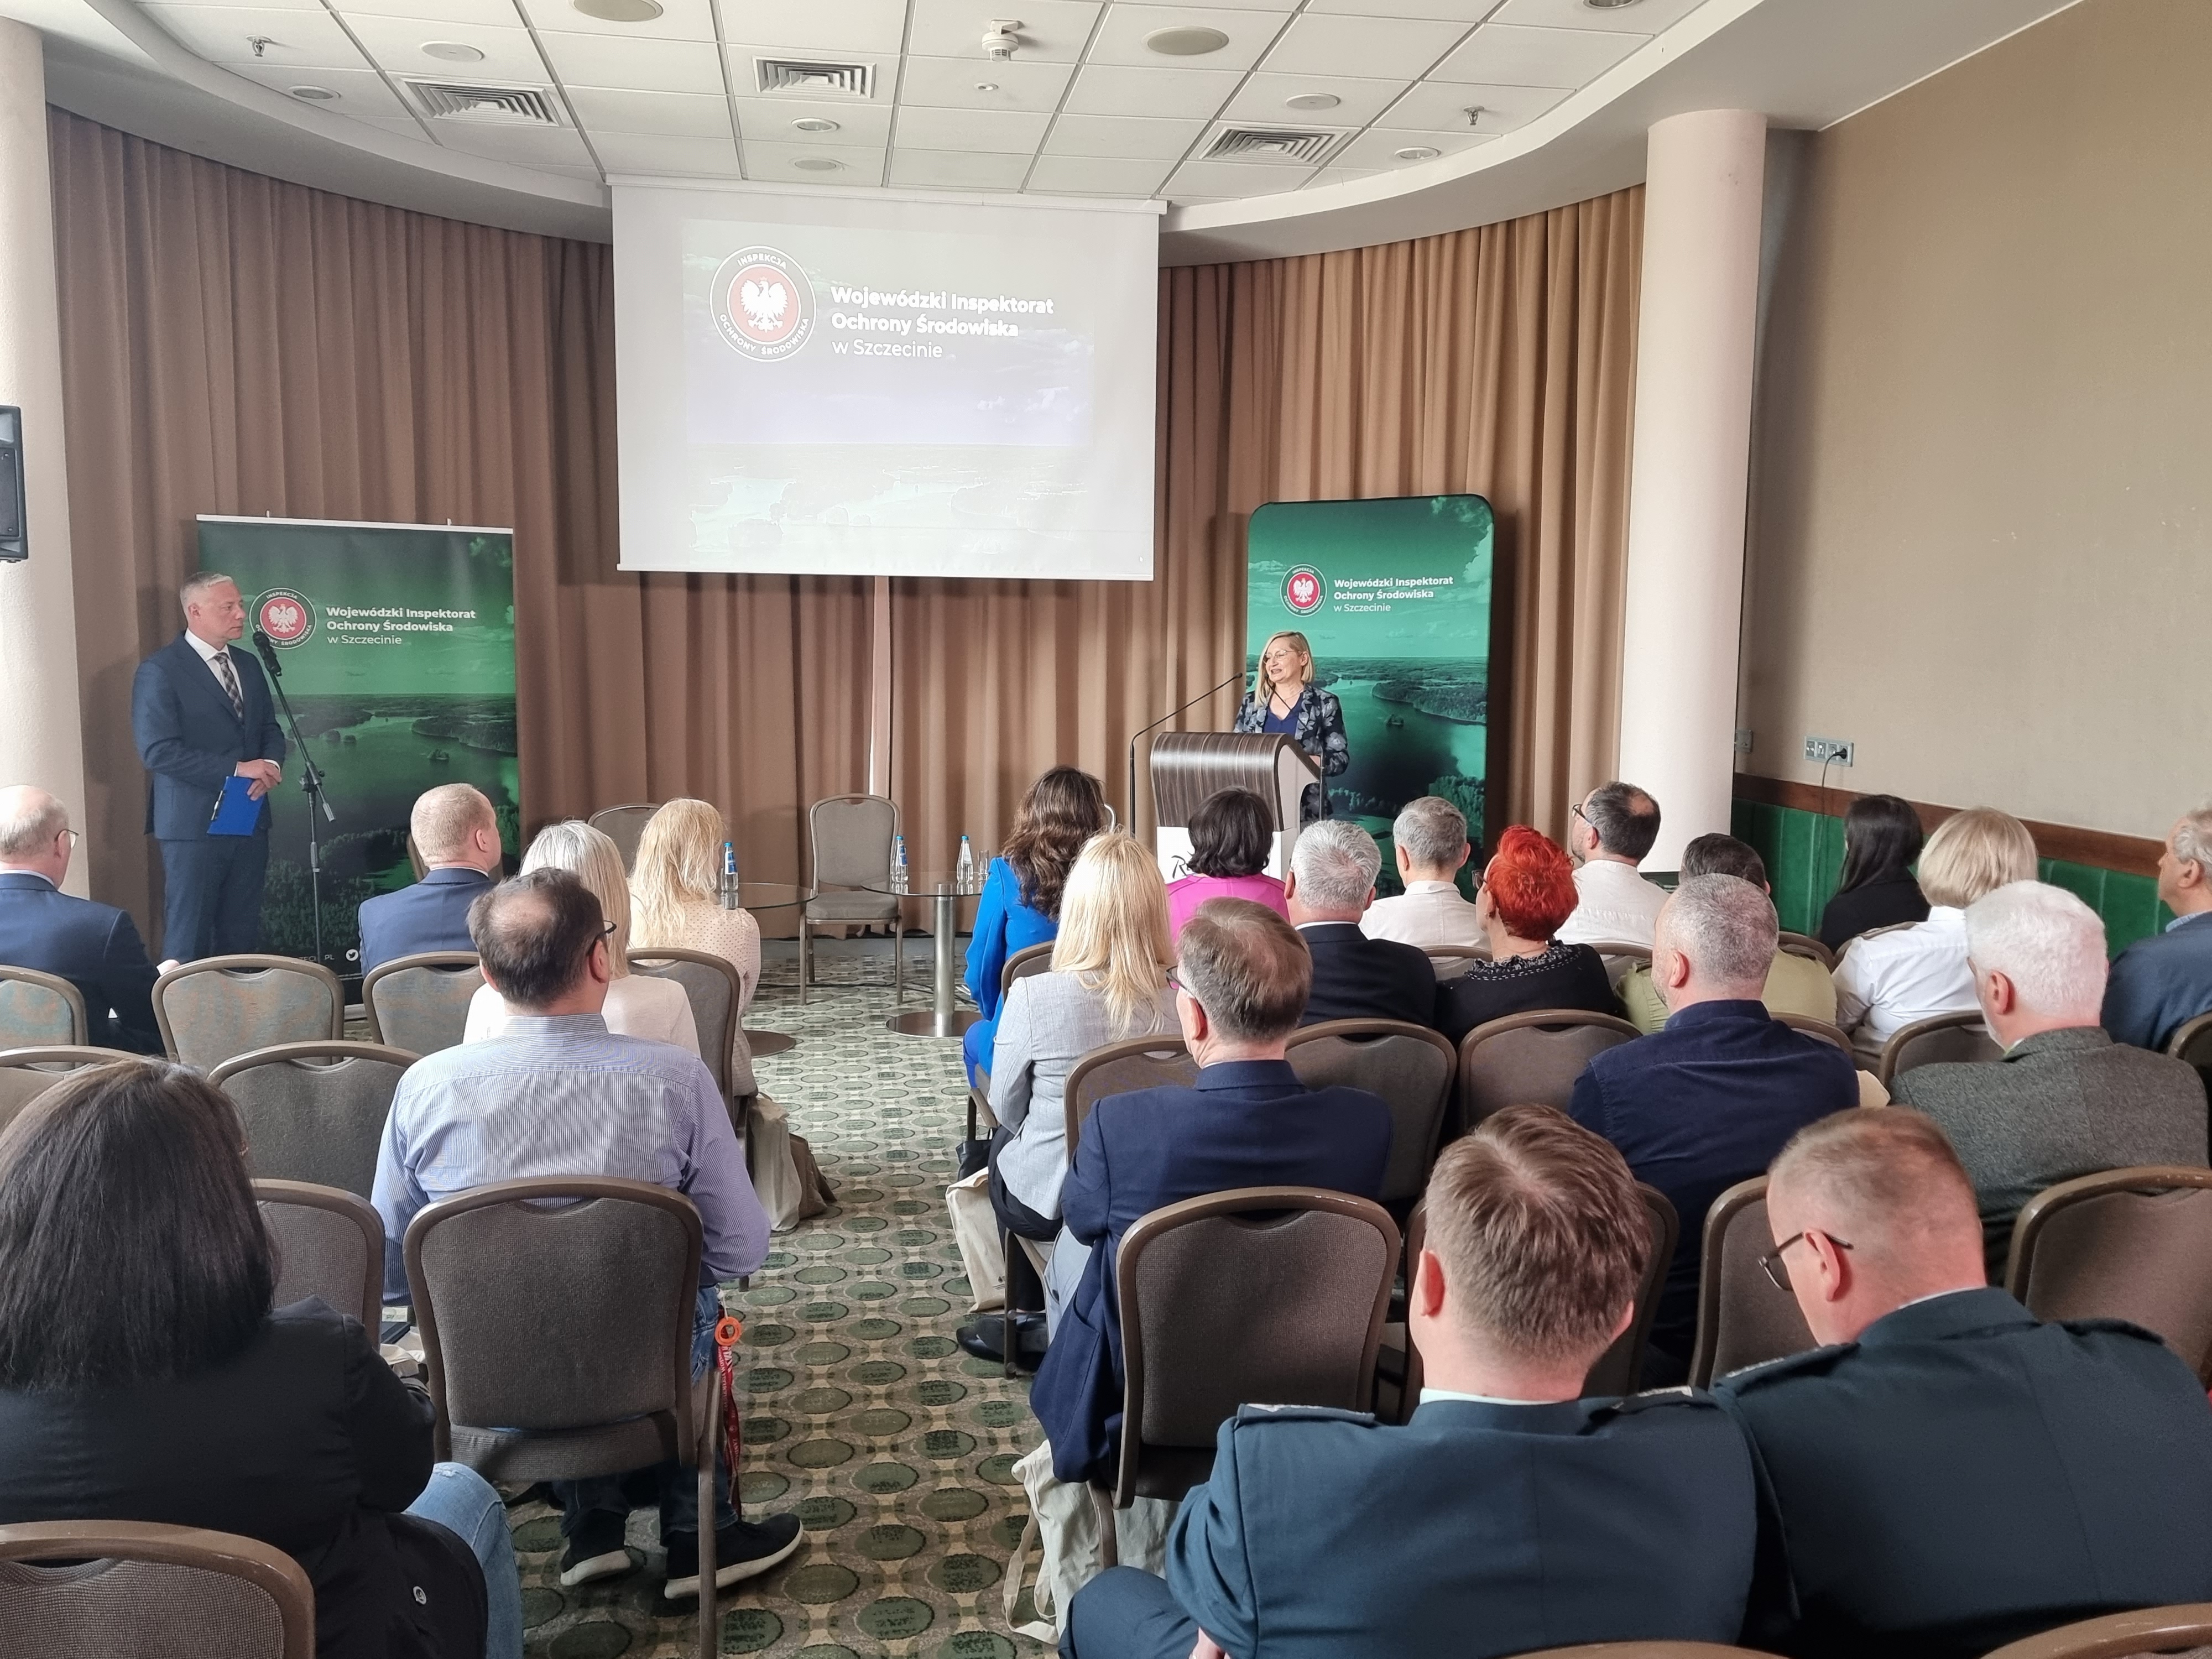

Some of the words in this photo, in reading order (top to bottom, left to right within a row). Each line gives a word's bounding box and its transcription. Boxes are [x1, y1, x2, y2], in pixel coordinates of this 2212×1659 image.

[737, 253, 786, 269] INSPEKCJA
[831, 286, 947, 311] Wojewódzki
[951, 291, 1054, 315] Inspektorat
[831, 312, 911, 337] Ochrony
[916, 314, 1019, 337] Środowiska
[720, 314, 757, 352] OCHRONY
[761, 318, 809, 355] ŚRODOWISKA
[832, 341, 848, 354] w
[853, 339, 943, 358] Szczecinie
[1334, 578, 1393, 589] Wojewódzki
[1395, 576, 1454, 588] Inspektorat
[1333, 591, 1374, 602] Ochrony
[1376, 589, 1434, 600] Środowiska
[326, 607, 403, 619] Wojewódzki
[406, 608, 476, 620] Inspektorat
[1344, 603, 1391, 612] Szczecinie
[326, 620, 380, 632] Ochrony
[383, 619, 453, 632] Środowiska
[341, 634, 402, 645] Szczecinie
